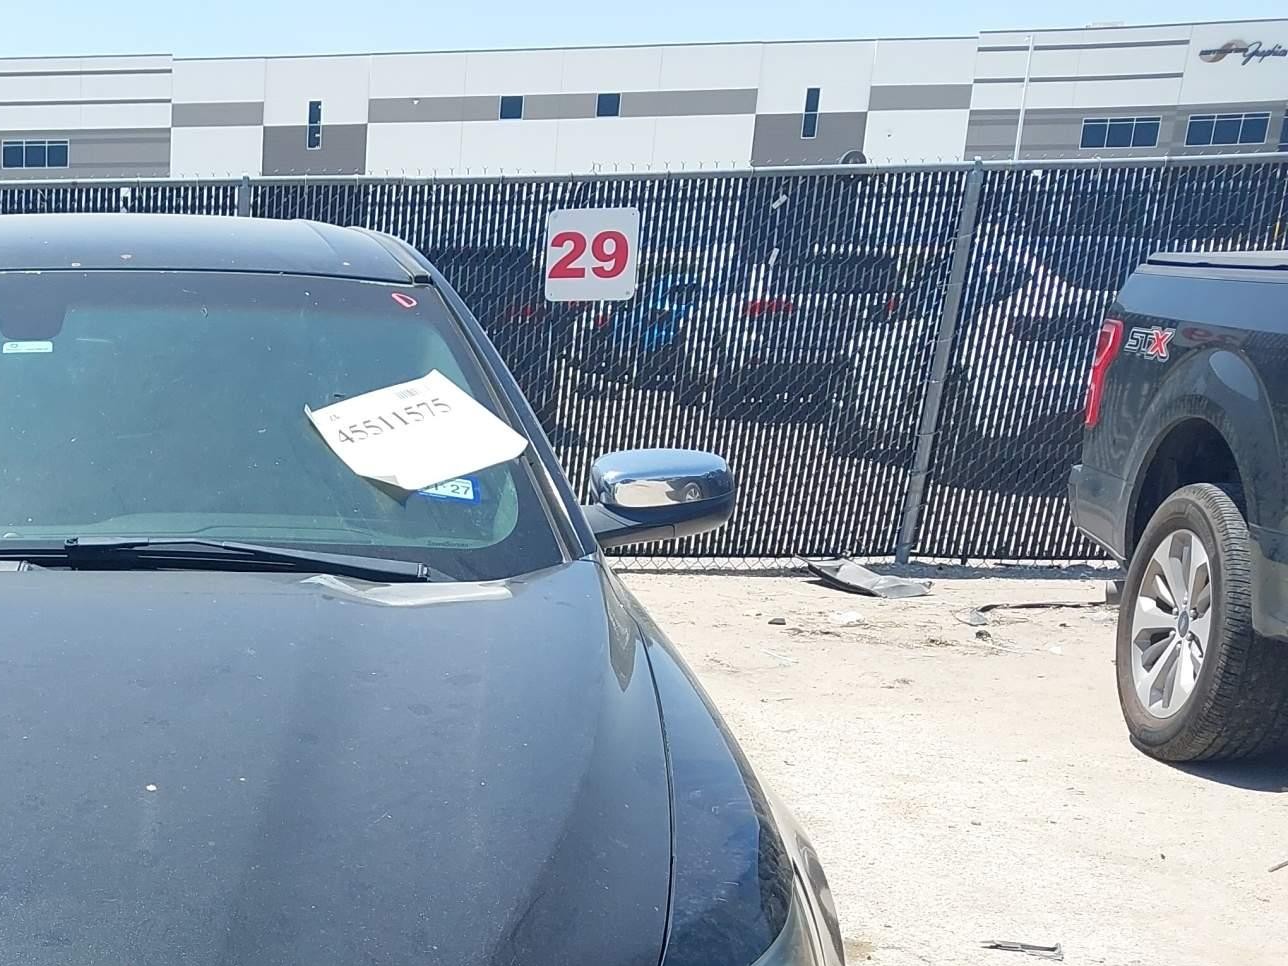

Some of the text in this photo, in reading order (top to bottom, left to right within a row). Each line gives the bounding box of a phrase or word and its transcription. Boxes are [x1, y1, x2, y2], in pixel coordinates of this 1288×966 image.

[548, 230, 629, 279] 29
[1123, 326, 1176, 362] STX
[337, 397, 452, 443] 45511575
[450, 484, 470, 495] 27
